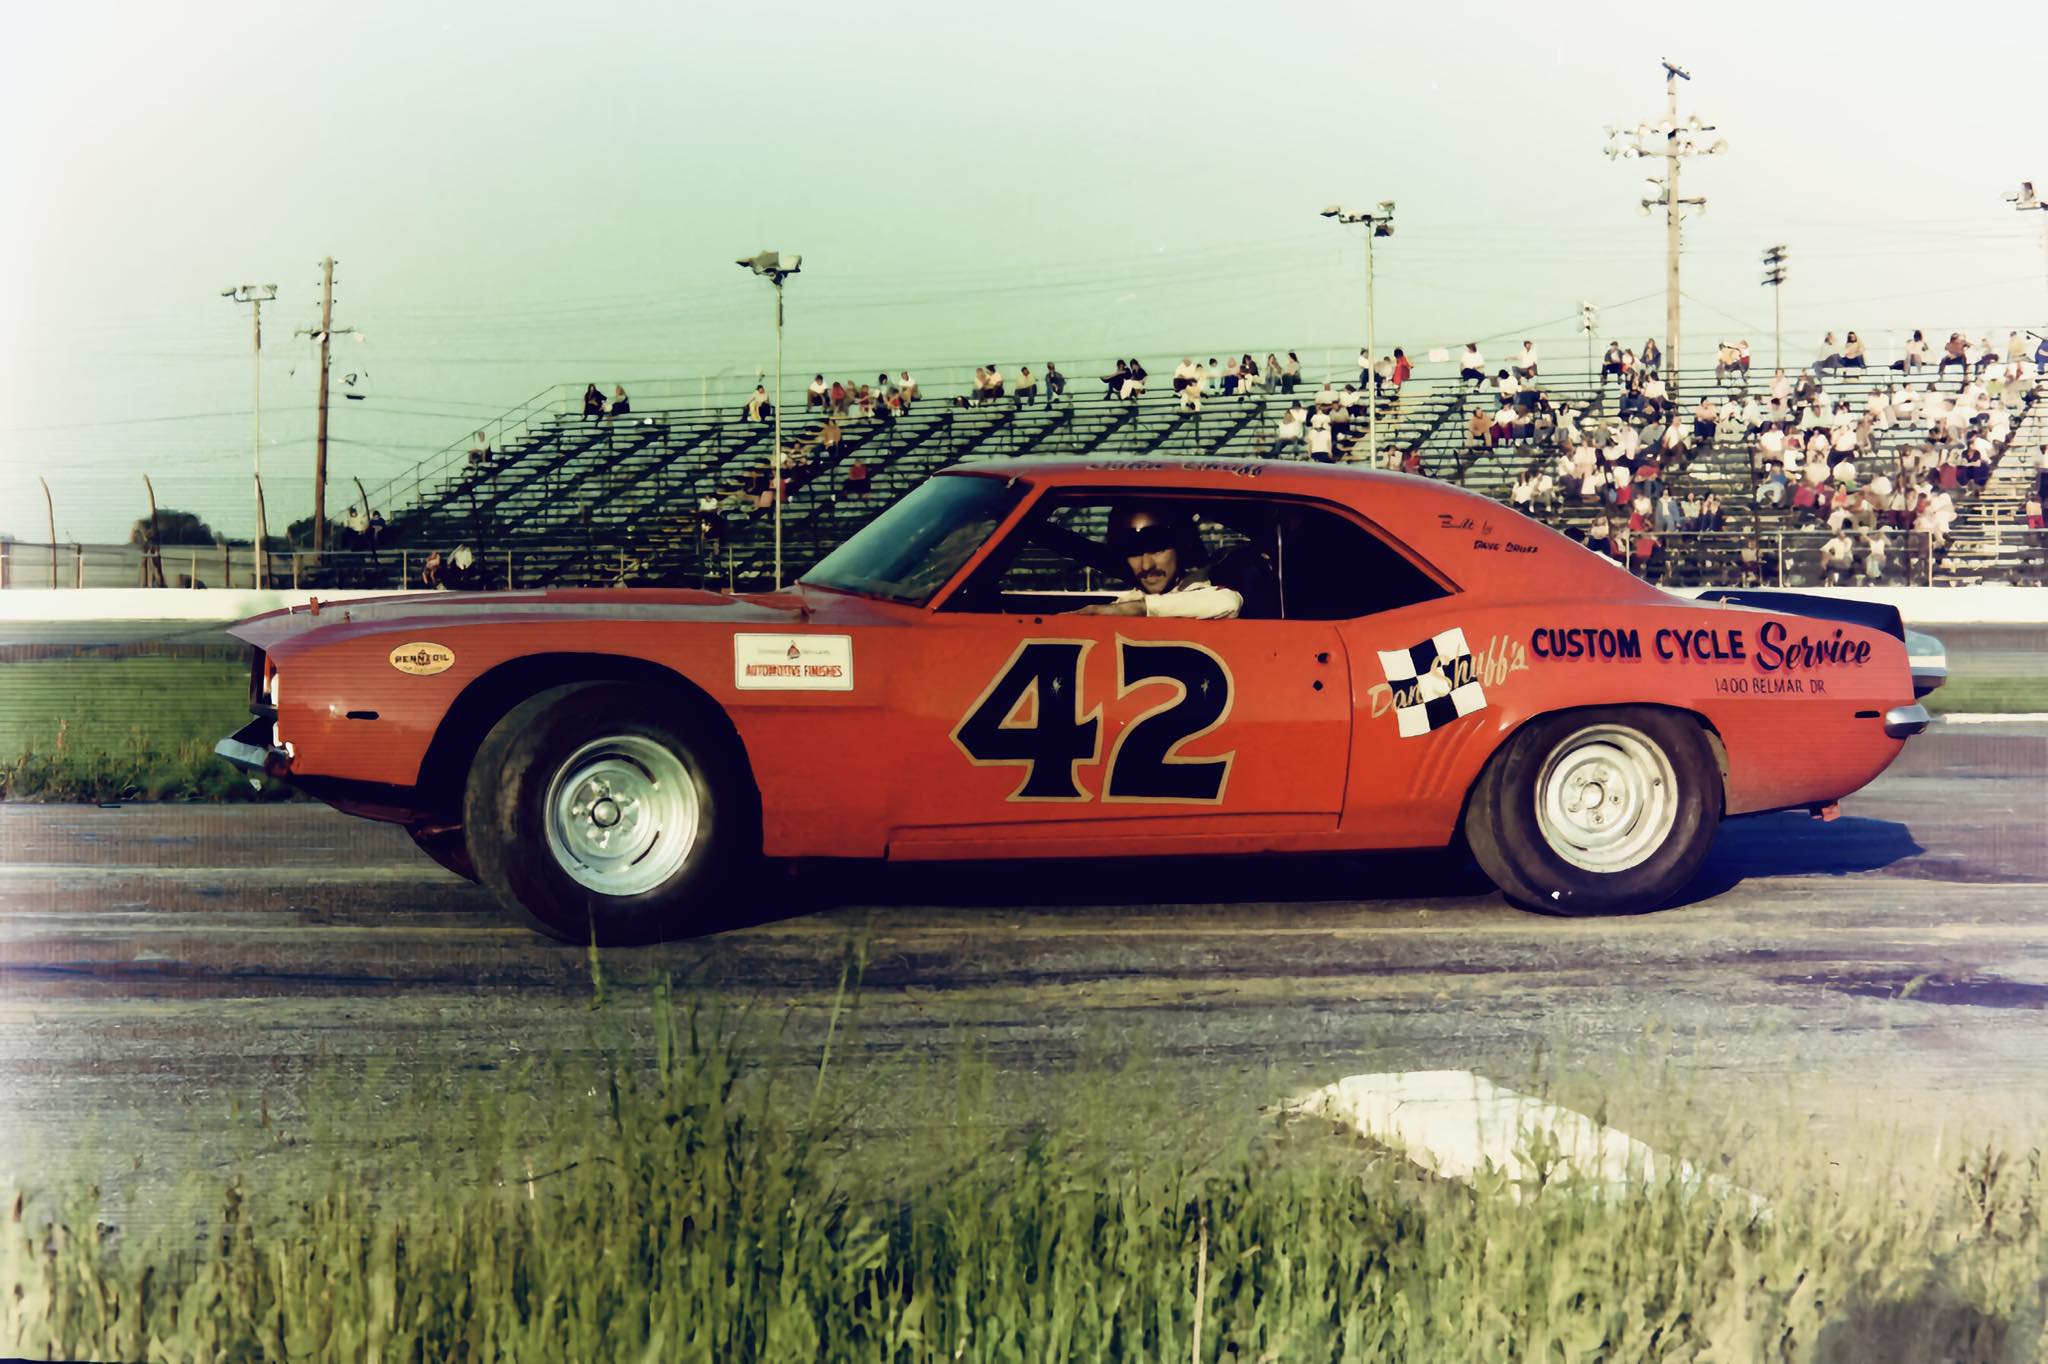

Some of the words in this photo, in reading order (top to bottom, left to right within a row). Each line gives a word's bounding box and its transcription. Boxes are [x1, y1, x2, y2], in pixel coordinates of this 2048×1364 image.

[1367, 681, 1425, 719] Dan
[1430, 635, 1529, 698] Shuff's
[1531, 628, 1641, 660] CUSTOM
[1655, 629, 1747, 661] CYCLE
[1756, 621, 1871, 671] Service
[949, 632, 1236, 805] 42
[1714, 677, 1748, 694] 1400
[1752, 677, 1804, 694] BELMAR
[1810, 678, 1827, 695] DR
